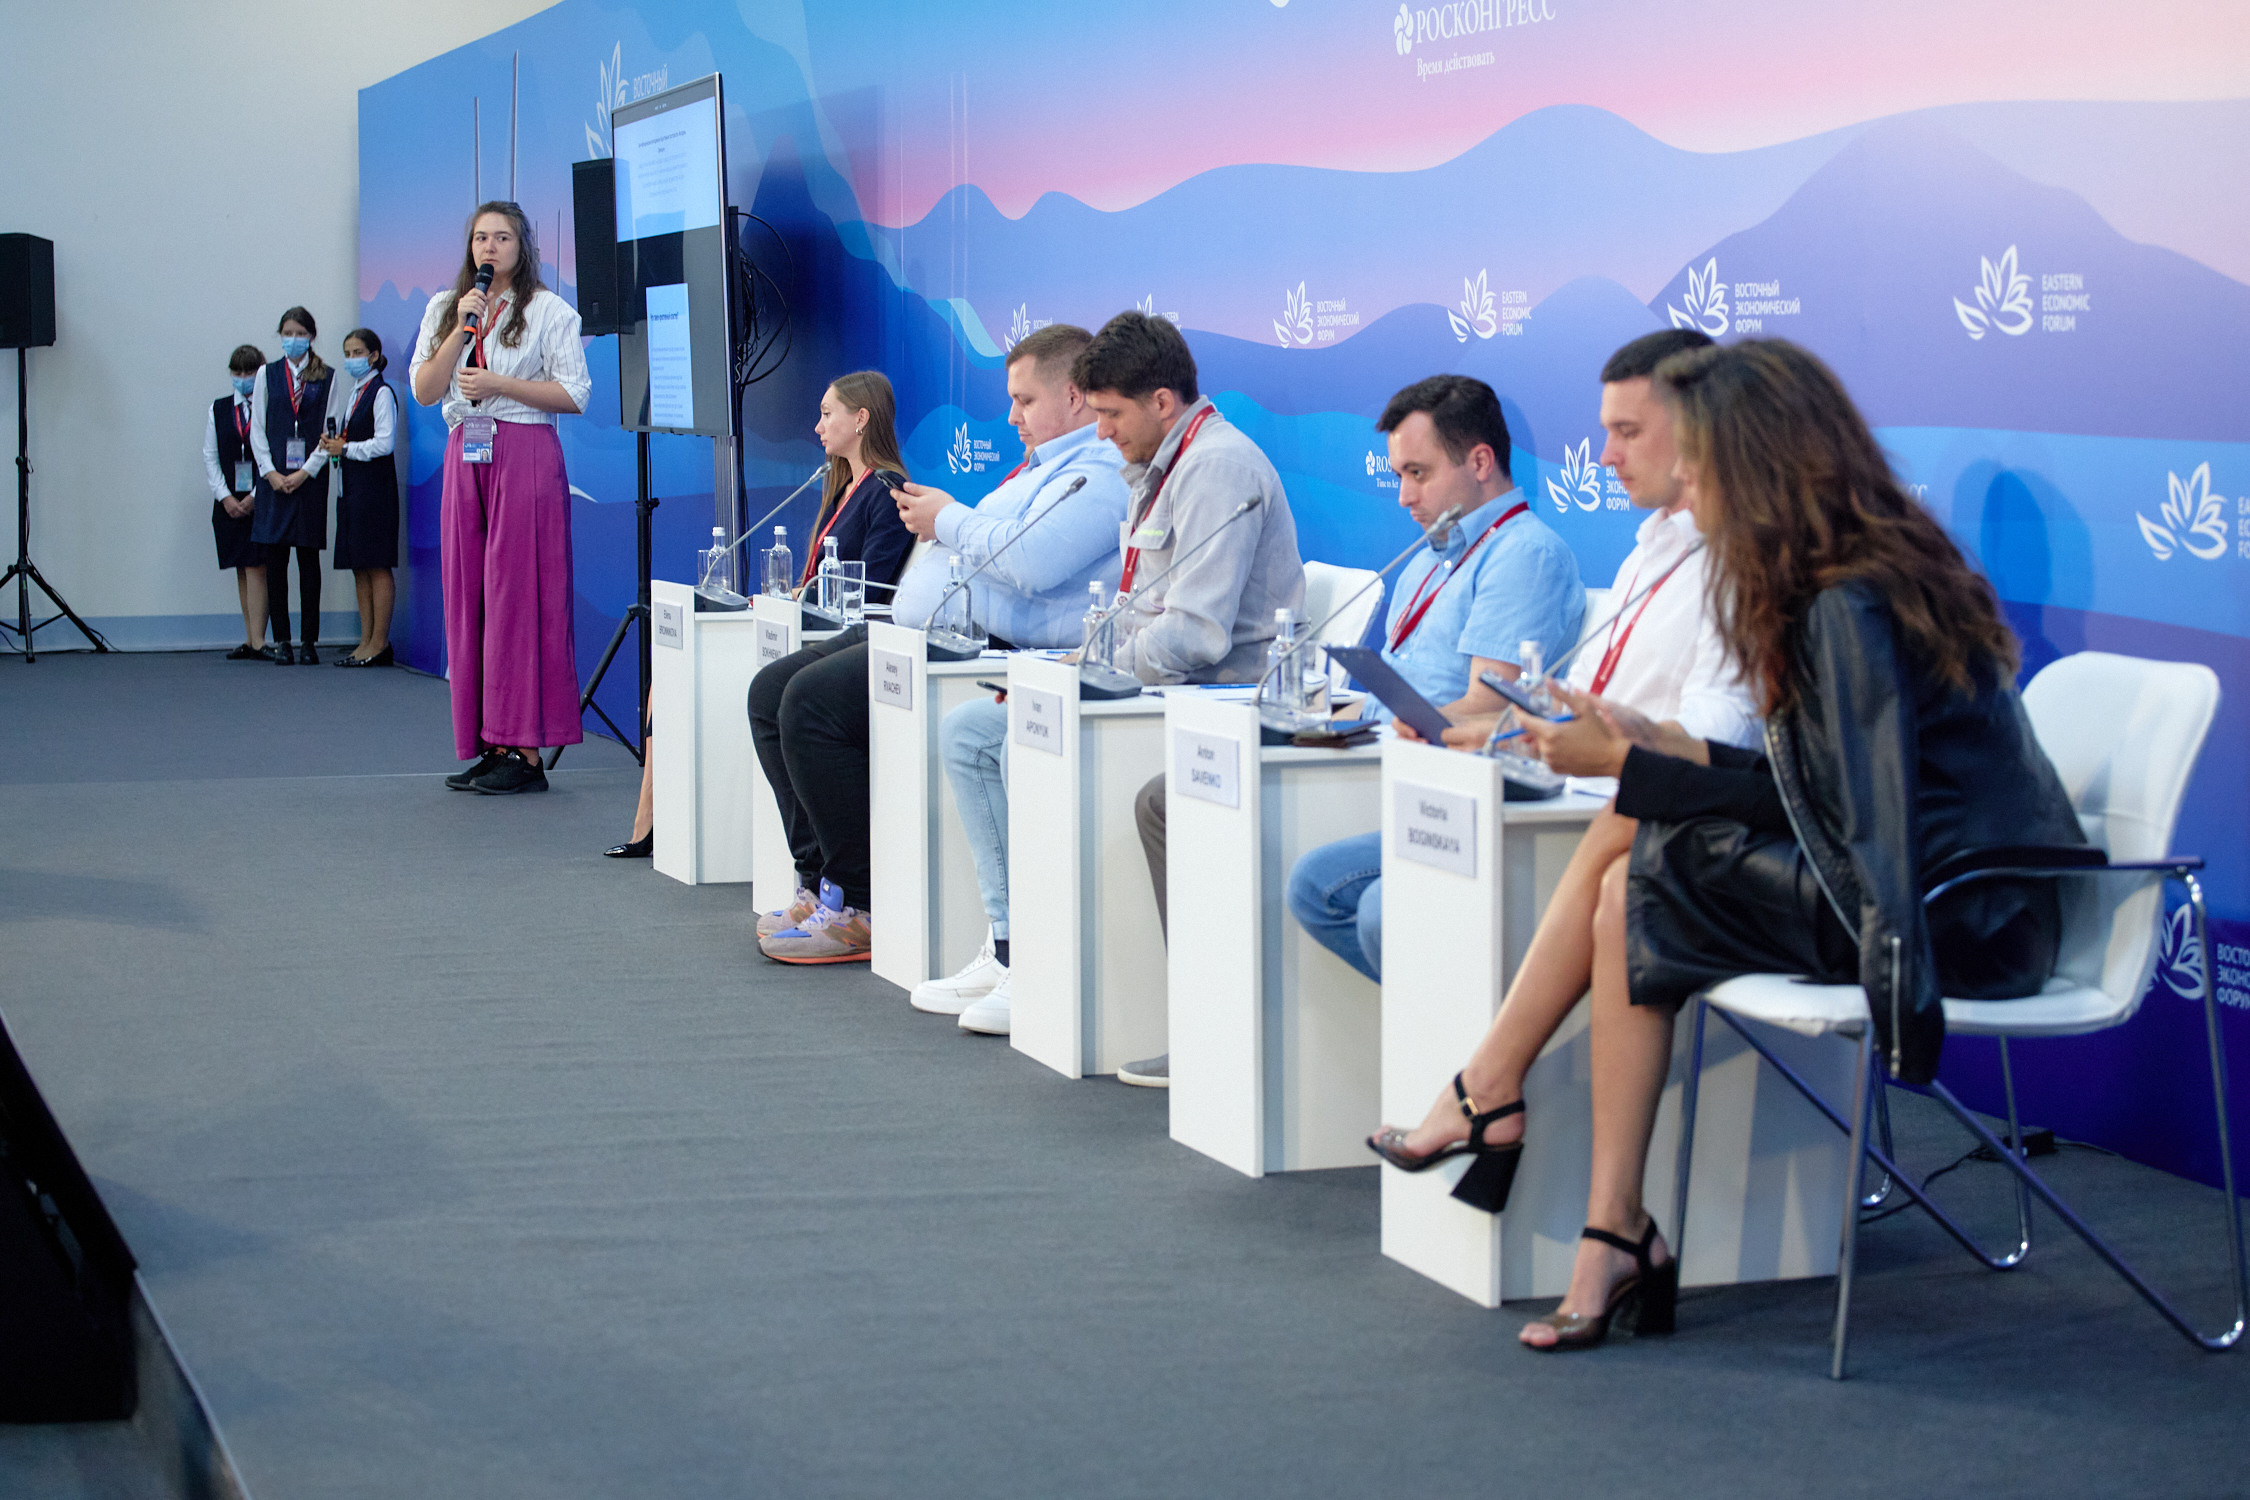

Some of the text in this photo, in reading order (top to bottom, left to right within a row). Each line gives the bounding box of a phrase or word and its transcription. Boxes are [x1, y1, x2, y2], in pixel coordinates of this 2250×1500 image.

[1417, 51, 1496, 82] Время действовать
[1735, 279, 1780, 298] ВОСТОЧНЫЙ
[2042, 273, 2084, 291] EASTERN
[1316, 297, 1346, 313] ВОСТОЧНЫЙ
[1502, 290, 1528, 304] EASTERN
[2042, 294, 2091, 312] ECONOMIC
[1502, 306, 1532, 320] ECONOMIC
[1735, 297, 1801, 316] ЭКОНОМИЧЕСКИЙ
[1502, 322, 1523, 336] FORUM
[1735, 318, 1762, 334] ФОРУМ
[2042, 315, 2077, 332] FORUM
[1606, 497, 1630, 511] ФОРУМ
